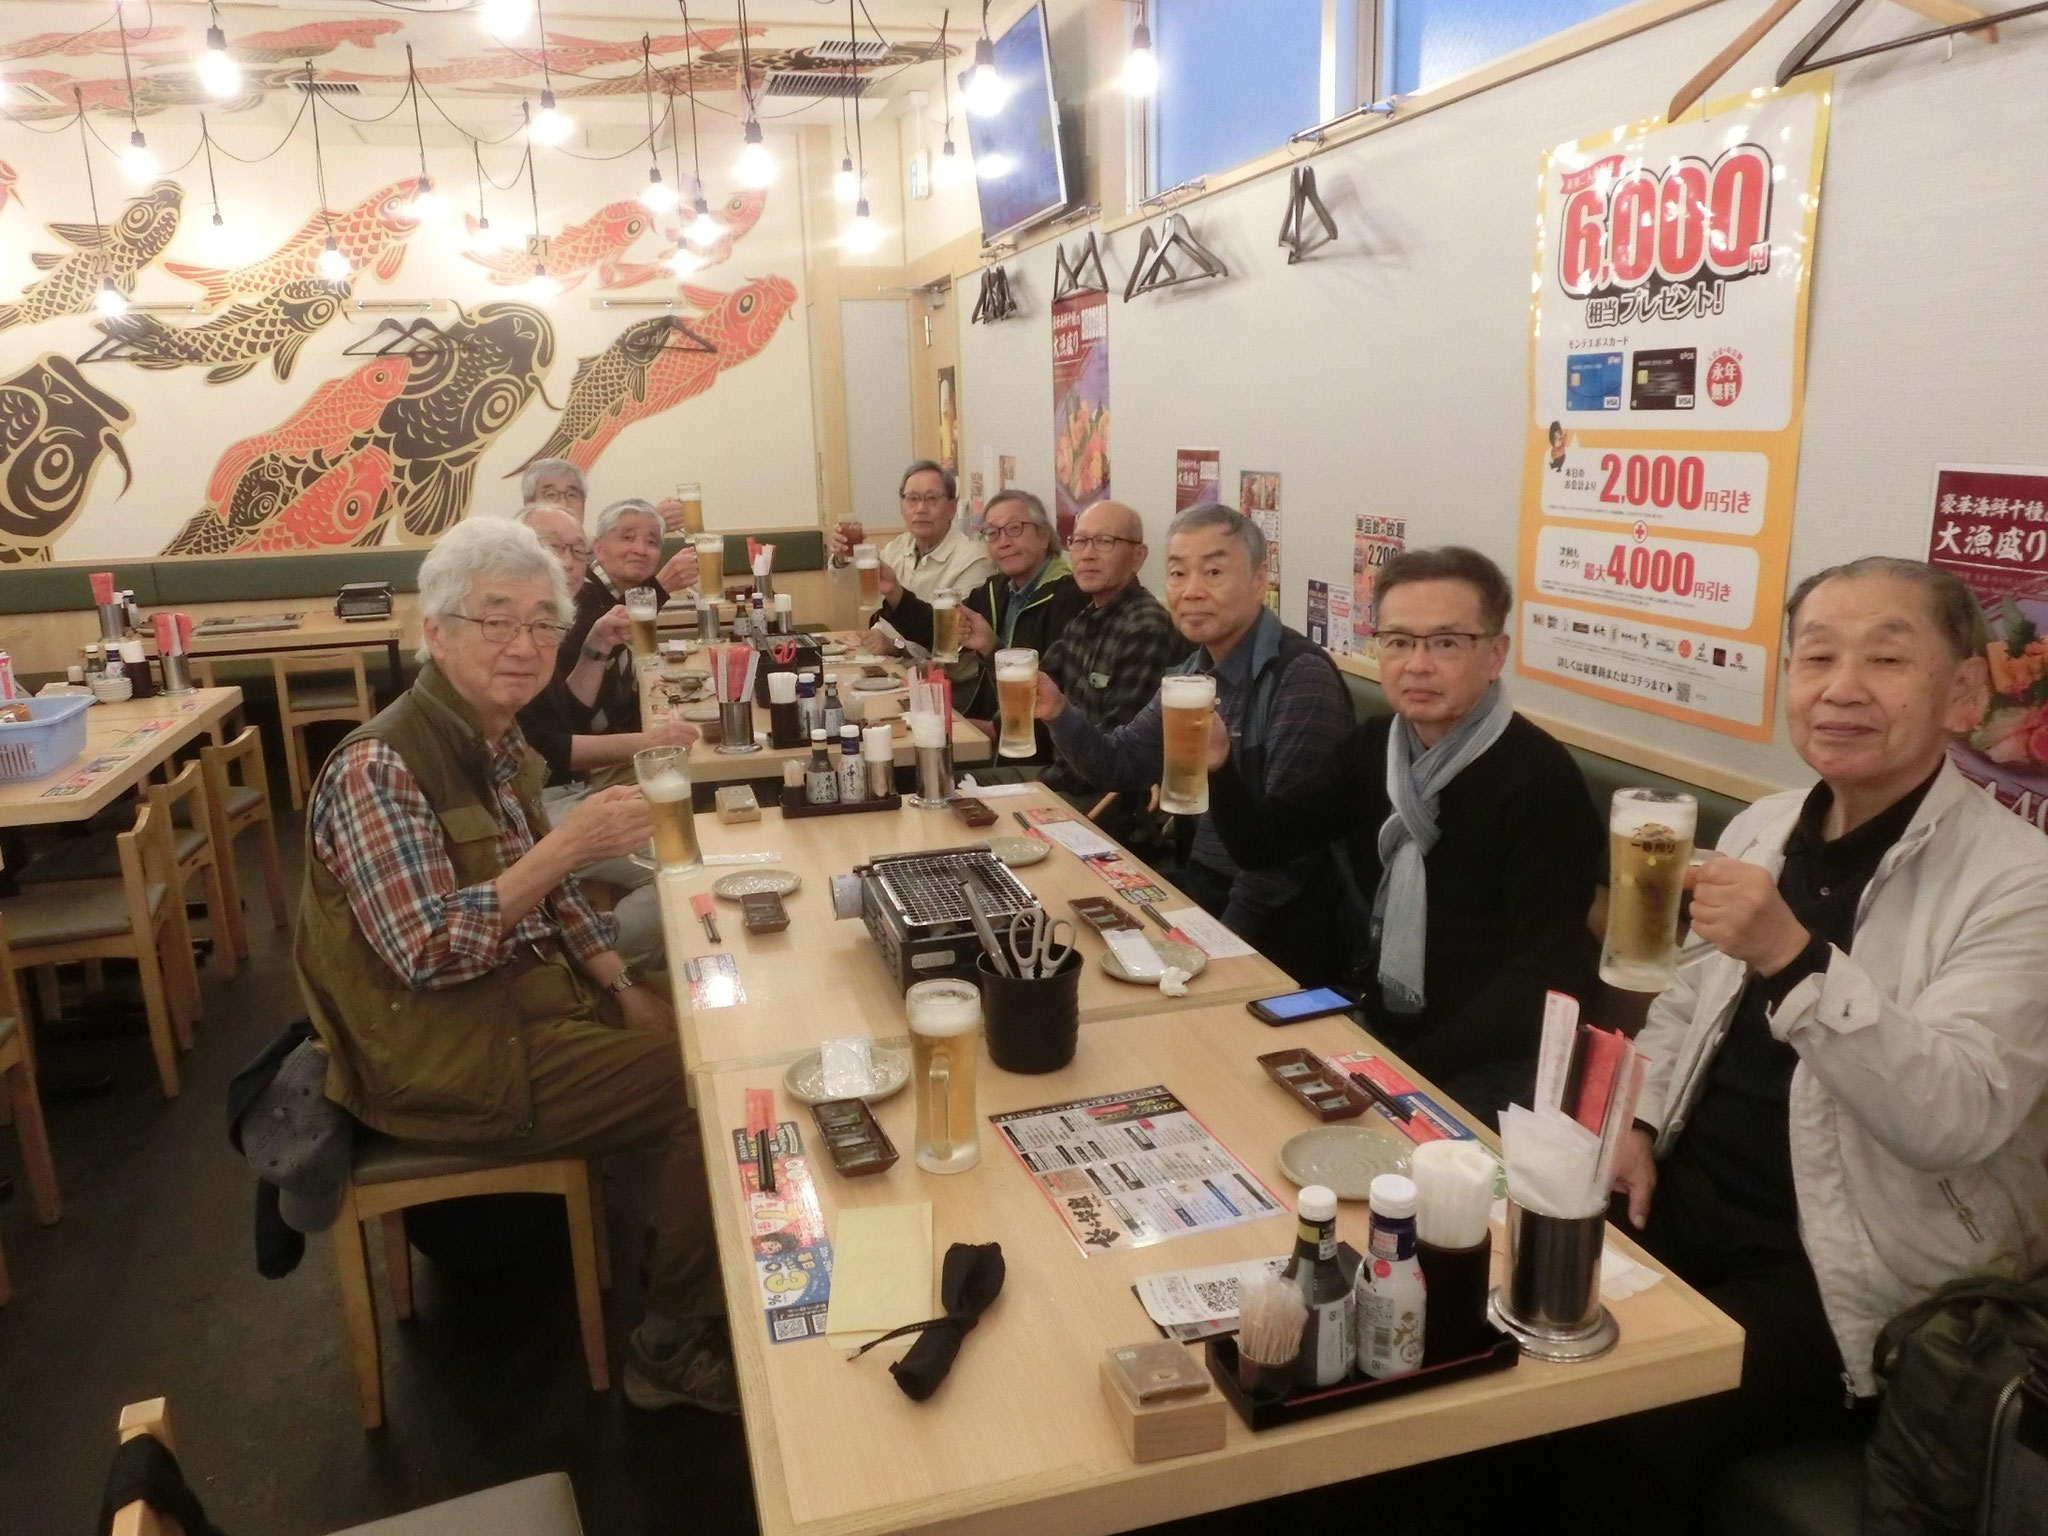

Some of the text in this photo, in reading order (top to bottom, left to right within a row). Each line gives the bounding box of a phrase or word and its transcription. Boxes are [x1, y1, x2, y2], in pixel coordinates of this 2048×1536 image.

[529, 237, 548, 256] 21
[1587, 280, 1725, 328] 相当プレゼント!
[1712, 361, 1739, 381] 永年
[1678, 397, 1692, 406] VISA
[1711, 382, 1737, 401] 無料
[1600, 452, 1752, 514] 2,000円引き
[1935, 521, 2048, 563] 大漁盛り
[1584, 545, 1732, 602] 最大4,000円引き
